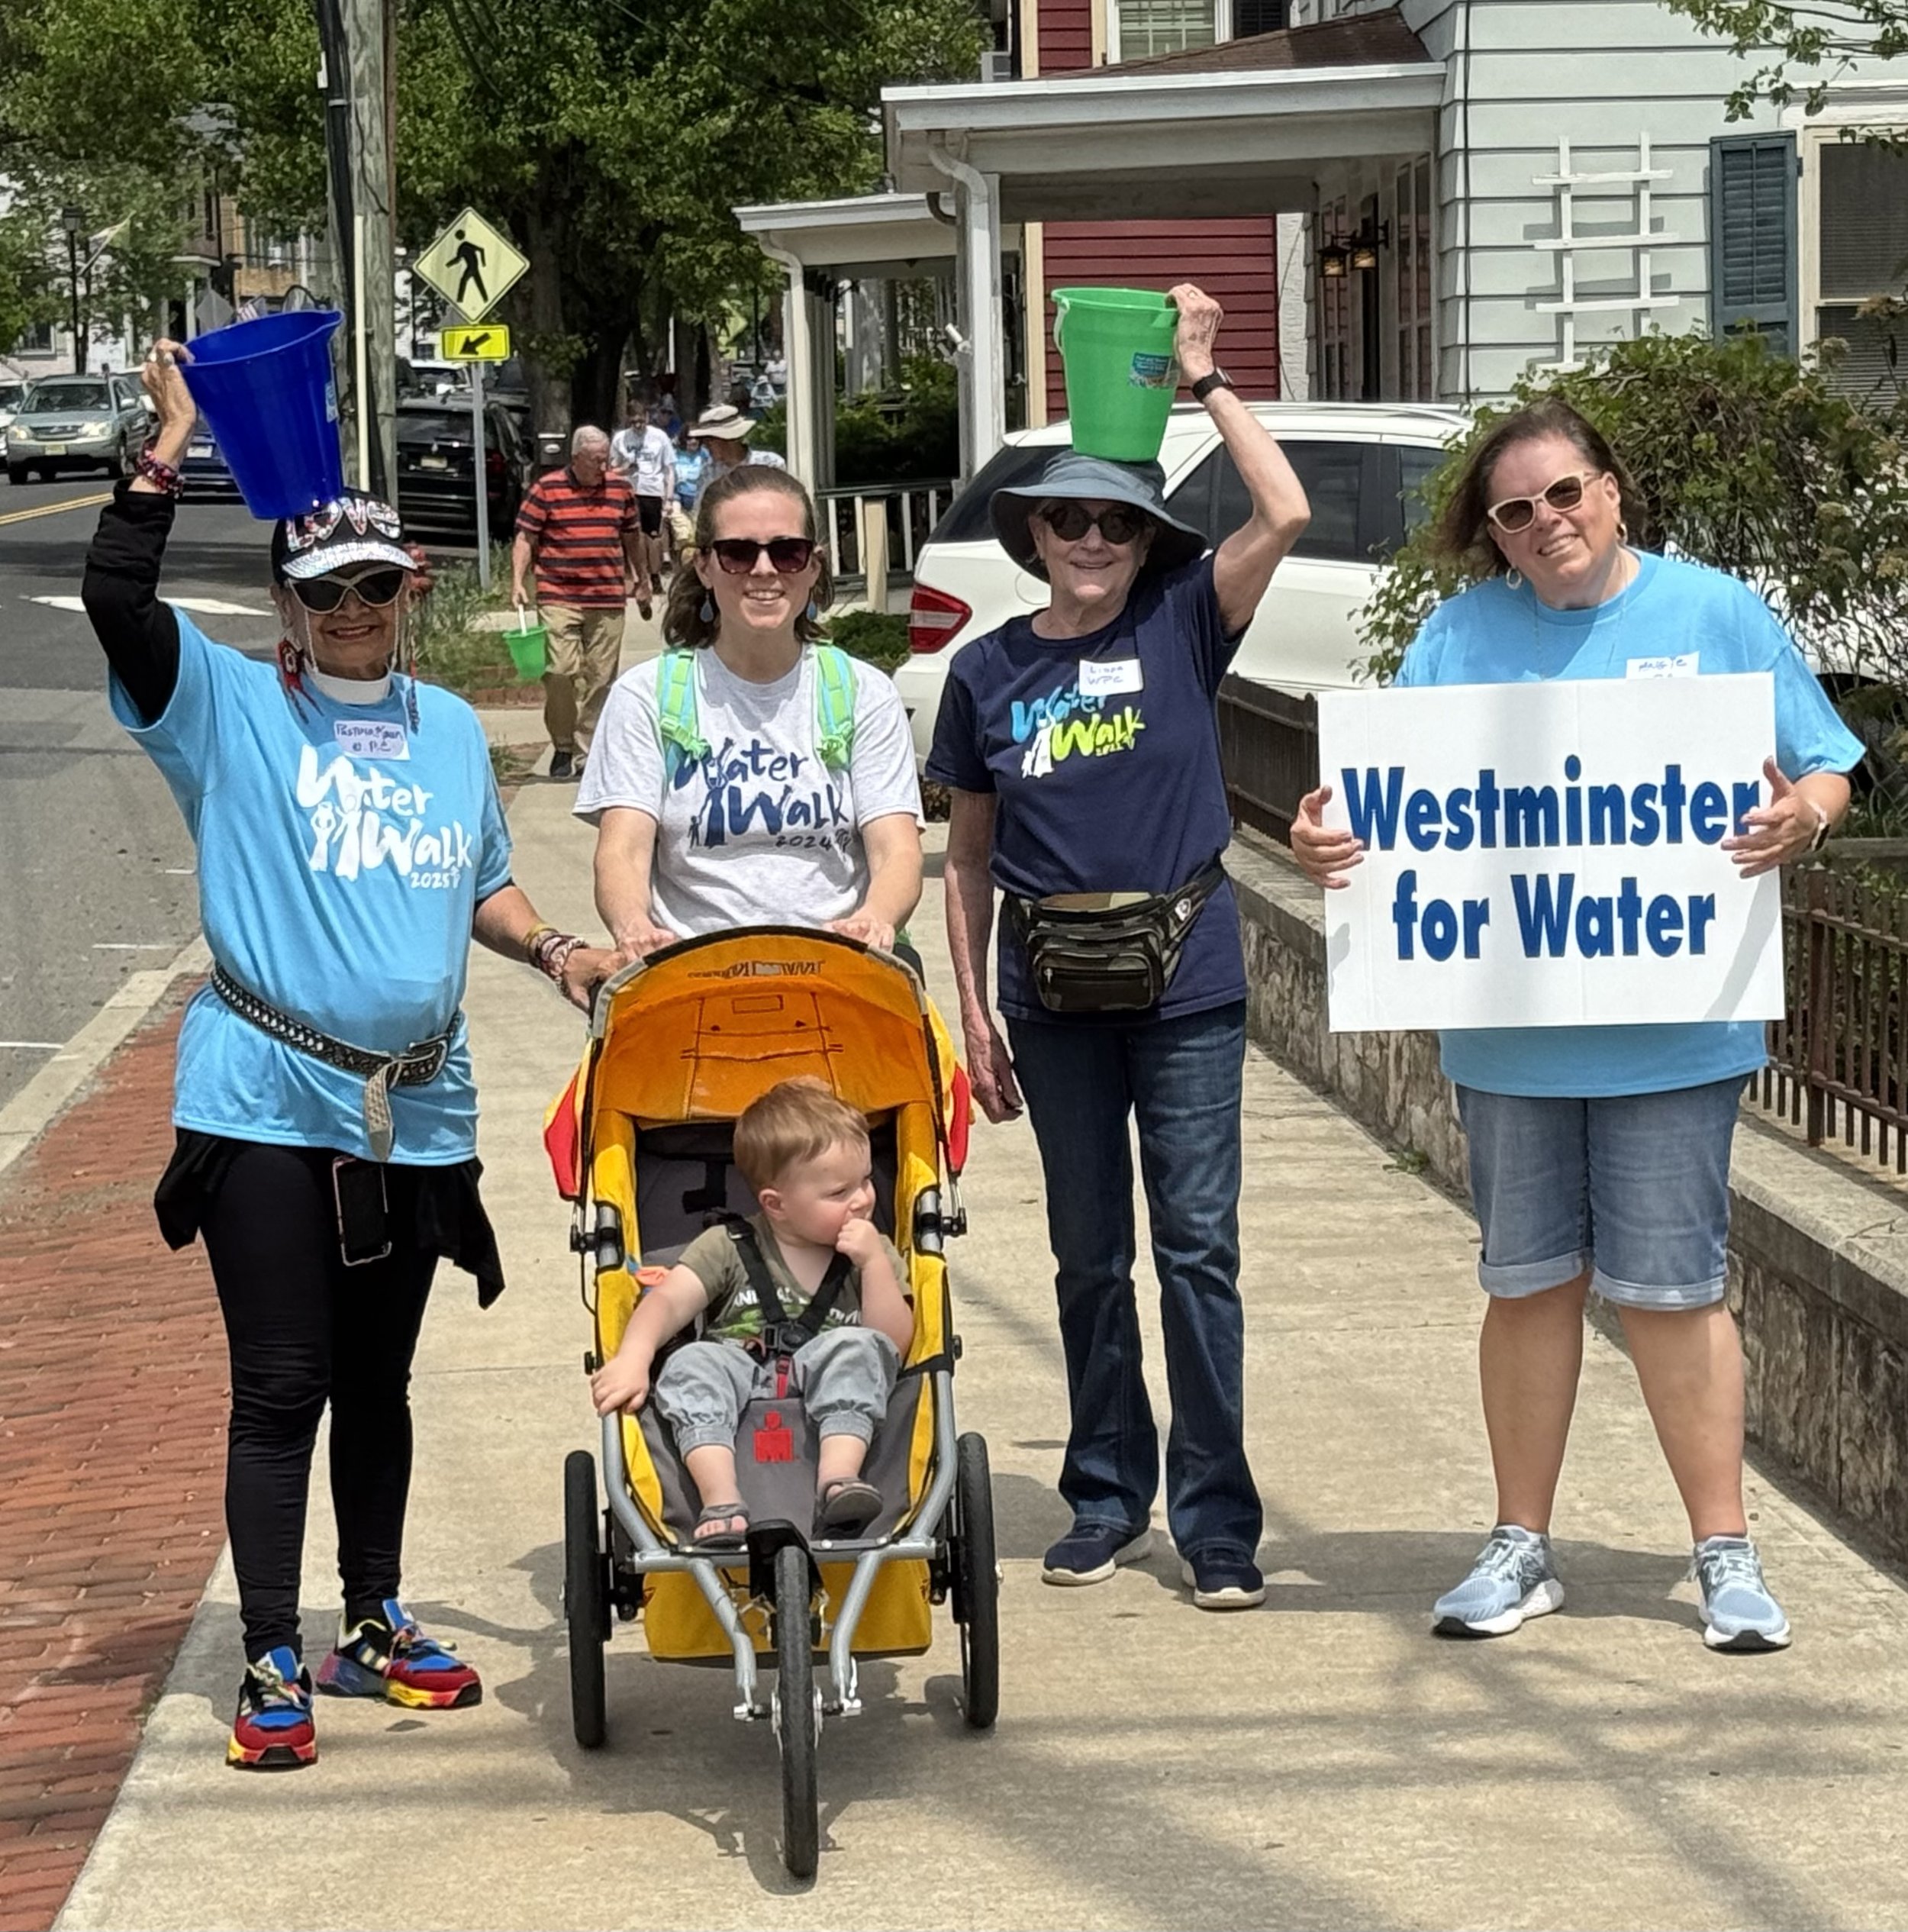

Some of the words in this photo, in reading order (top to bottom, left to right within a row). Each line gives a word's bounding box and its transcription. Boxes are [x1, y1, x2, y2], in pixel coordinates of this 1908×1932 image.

[1051, 706, 1146, 762] Walk
[727, 784, 849, 836] Walk
[1341, 753, 1761, 852] Westminster
[361, 811, 473, 876] Walk
[775, 834, 833, 852] 2024
[410, 871, 450, 889] 2025
[1392, 869, 1490, 962] for
[1510, 872, 1716, 960] Water
